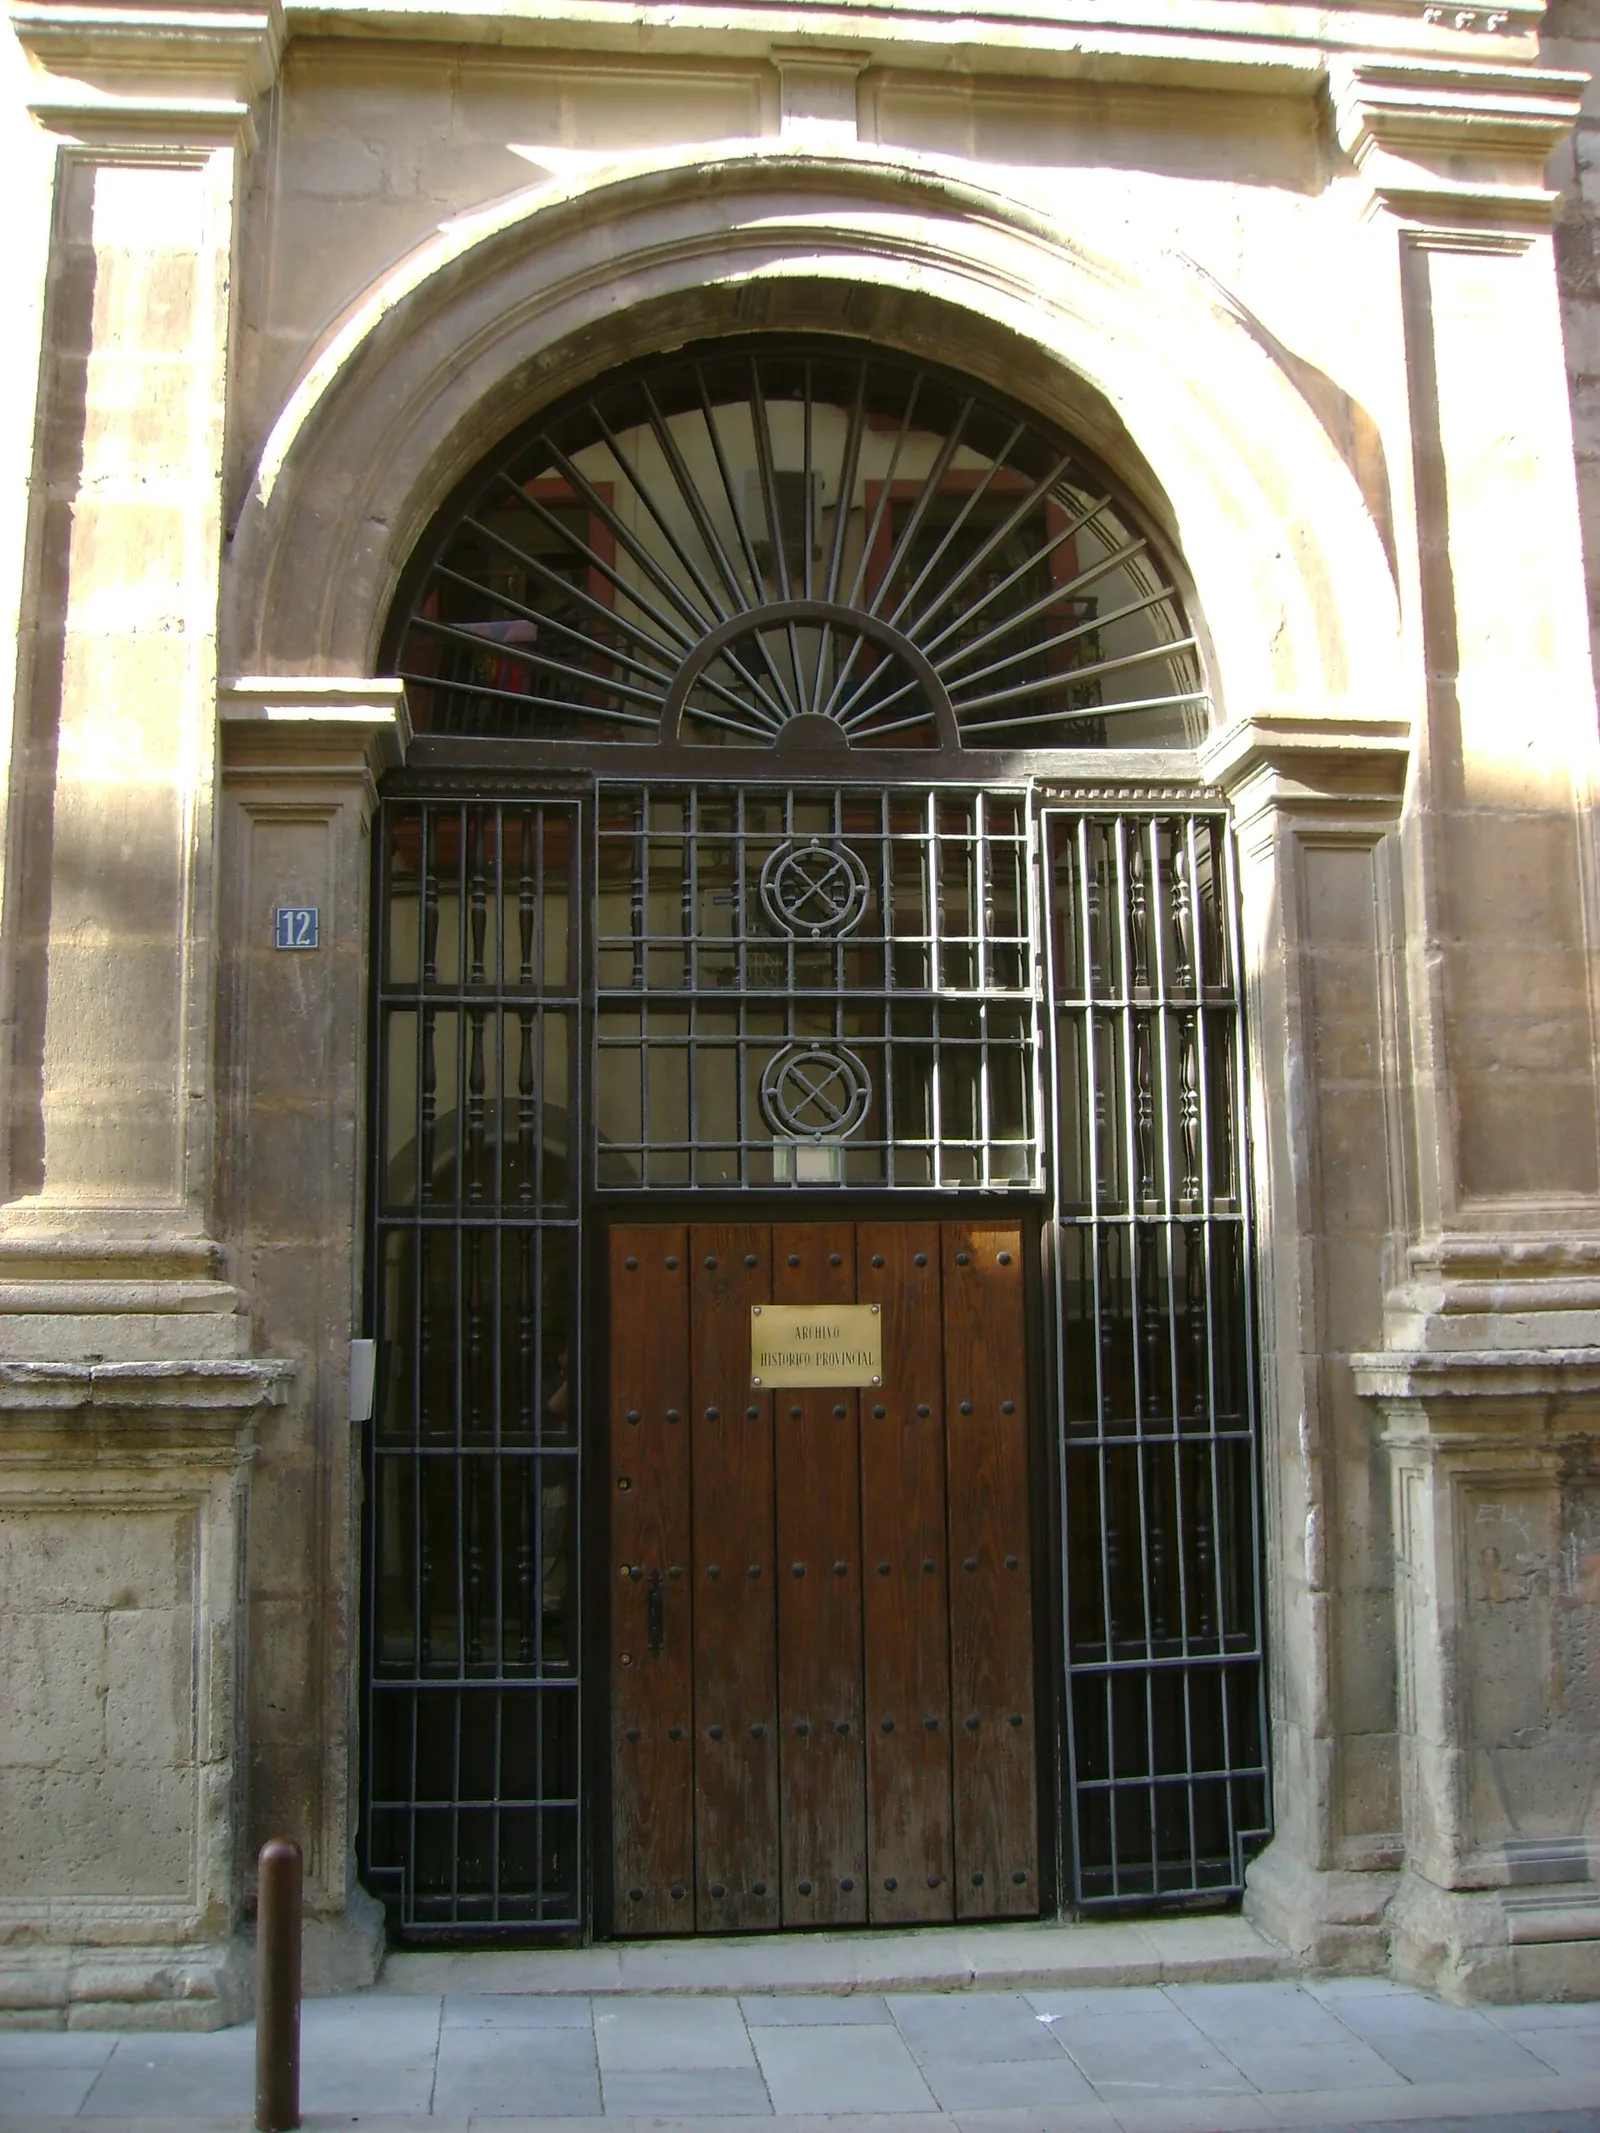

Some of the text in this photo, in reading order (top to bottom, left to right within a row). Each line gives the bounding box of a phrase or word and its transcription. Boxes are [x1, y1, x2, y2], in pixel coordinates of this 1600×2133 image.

[282, 911, 311, 945] 12
[795, 1326, 840, 1340] ARCHIVO
[760, 1351, 875, 1367] HISTORICO PROVINCIAL
